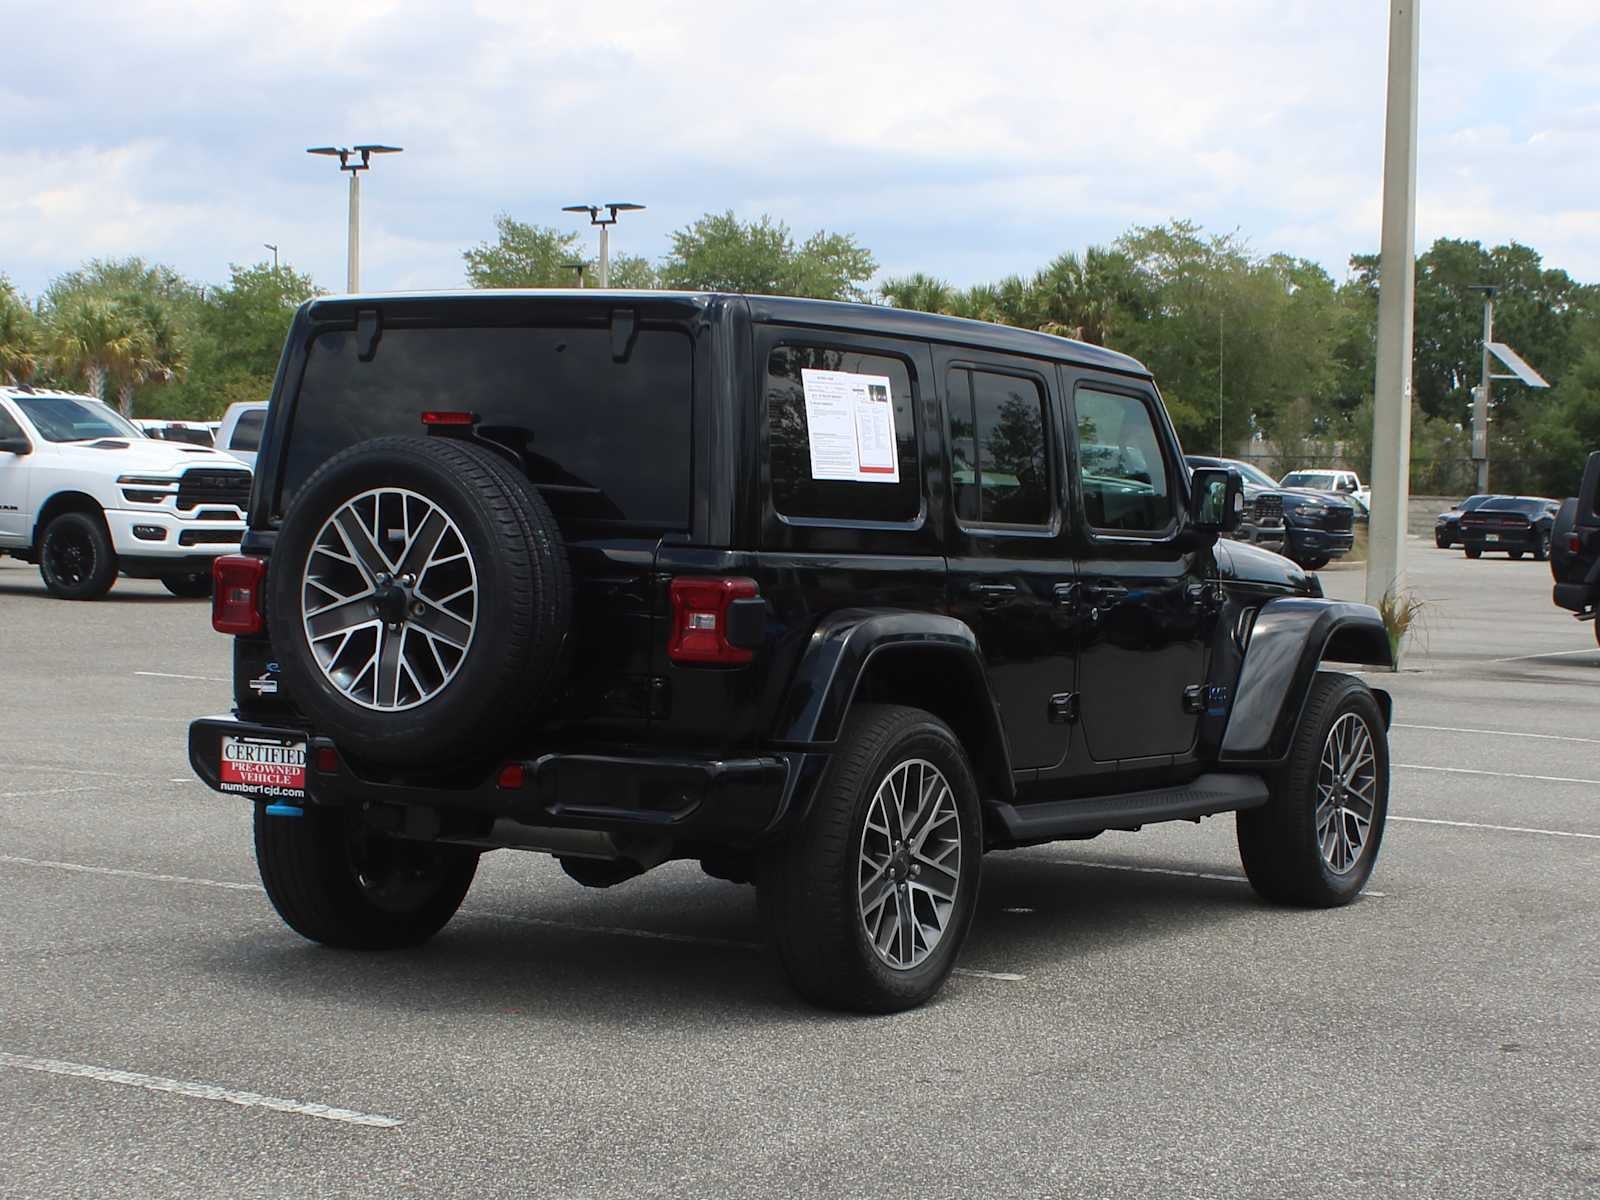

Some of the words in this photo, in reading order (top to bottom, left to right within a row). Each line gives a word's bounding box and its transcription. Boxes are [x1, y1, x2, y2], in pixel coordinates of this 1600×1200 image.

[225, 743, 307, 765] CERTIFIED
[231, 762, 300, 776] PRE-OWNED
[240, 771, 292, 785] VEHICLE
[220, 782, 304, 797] number1cjd.com
